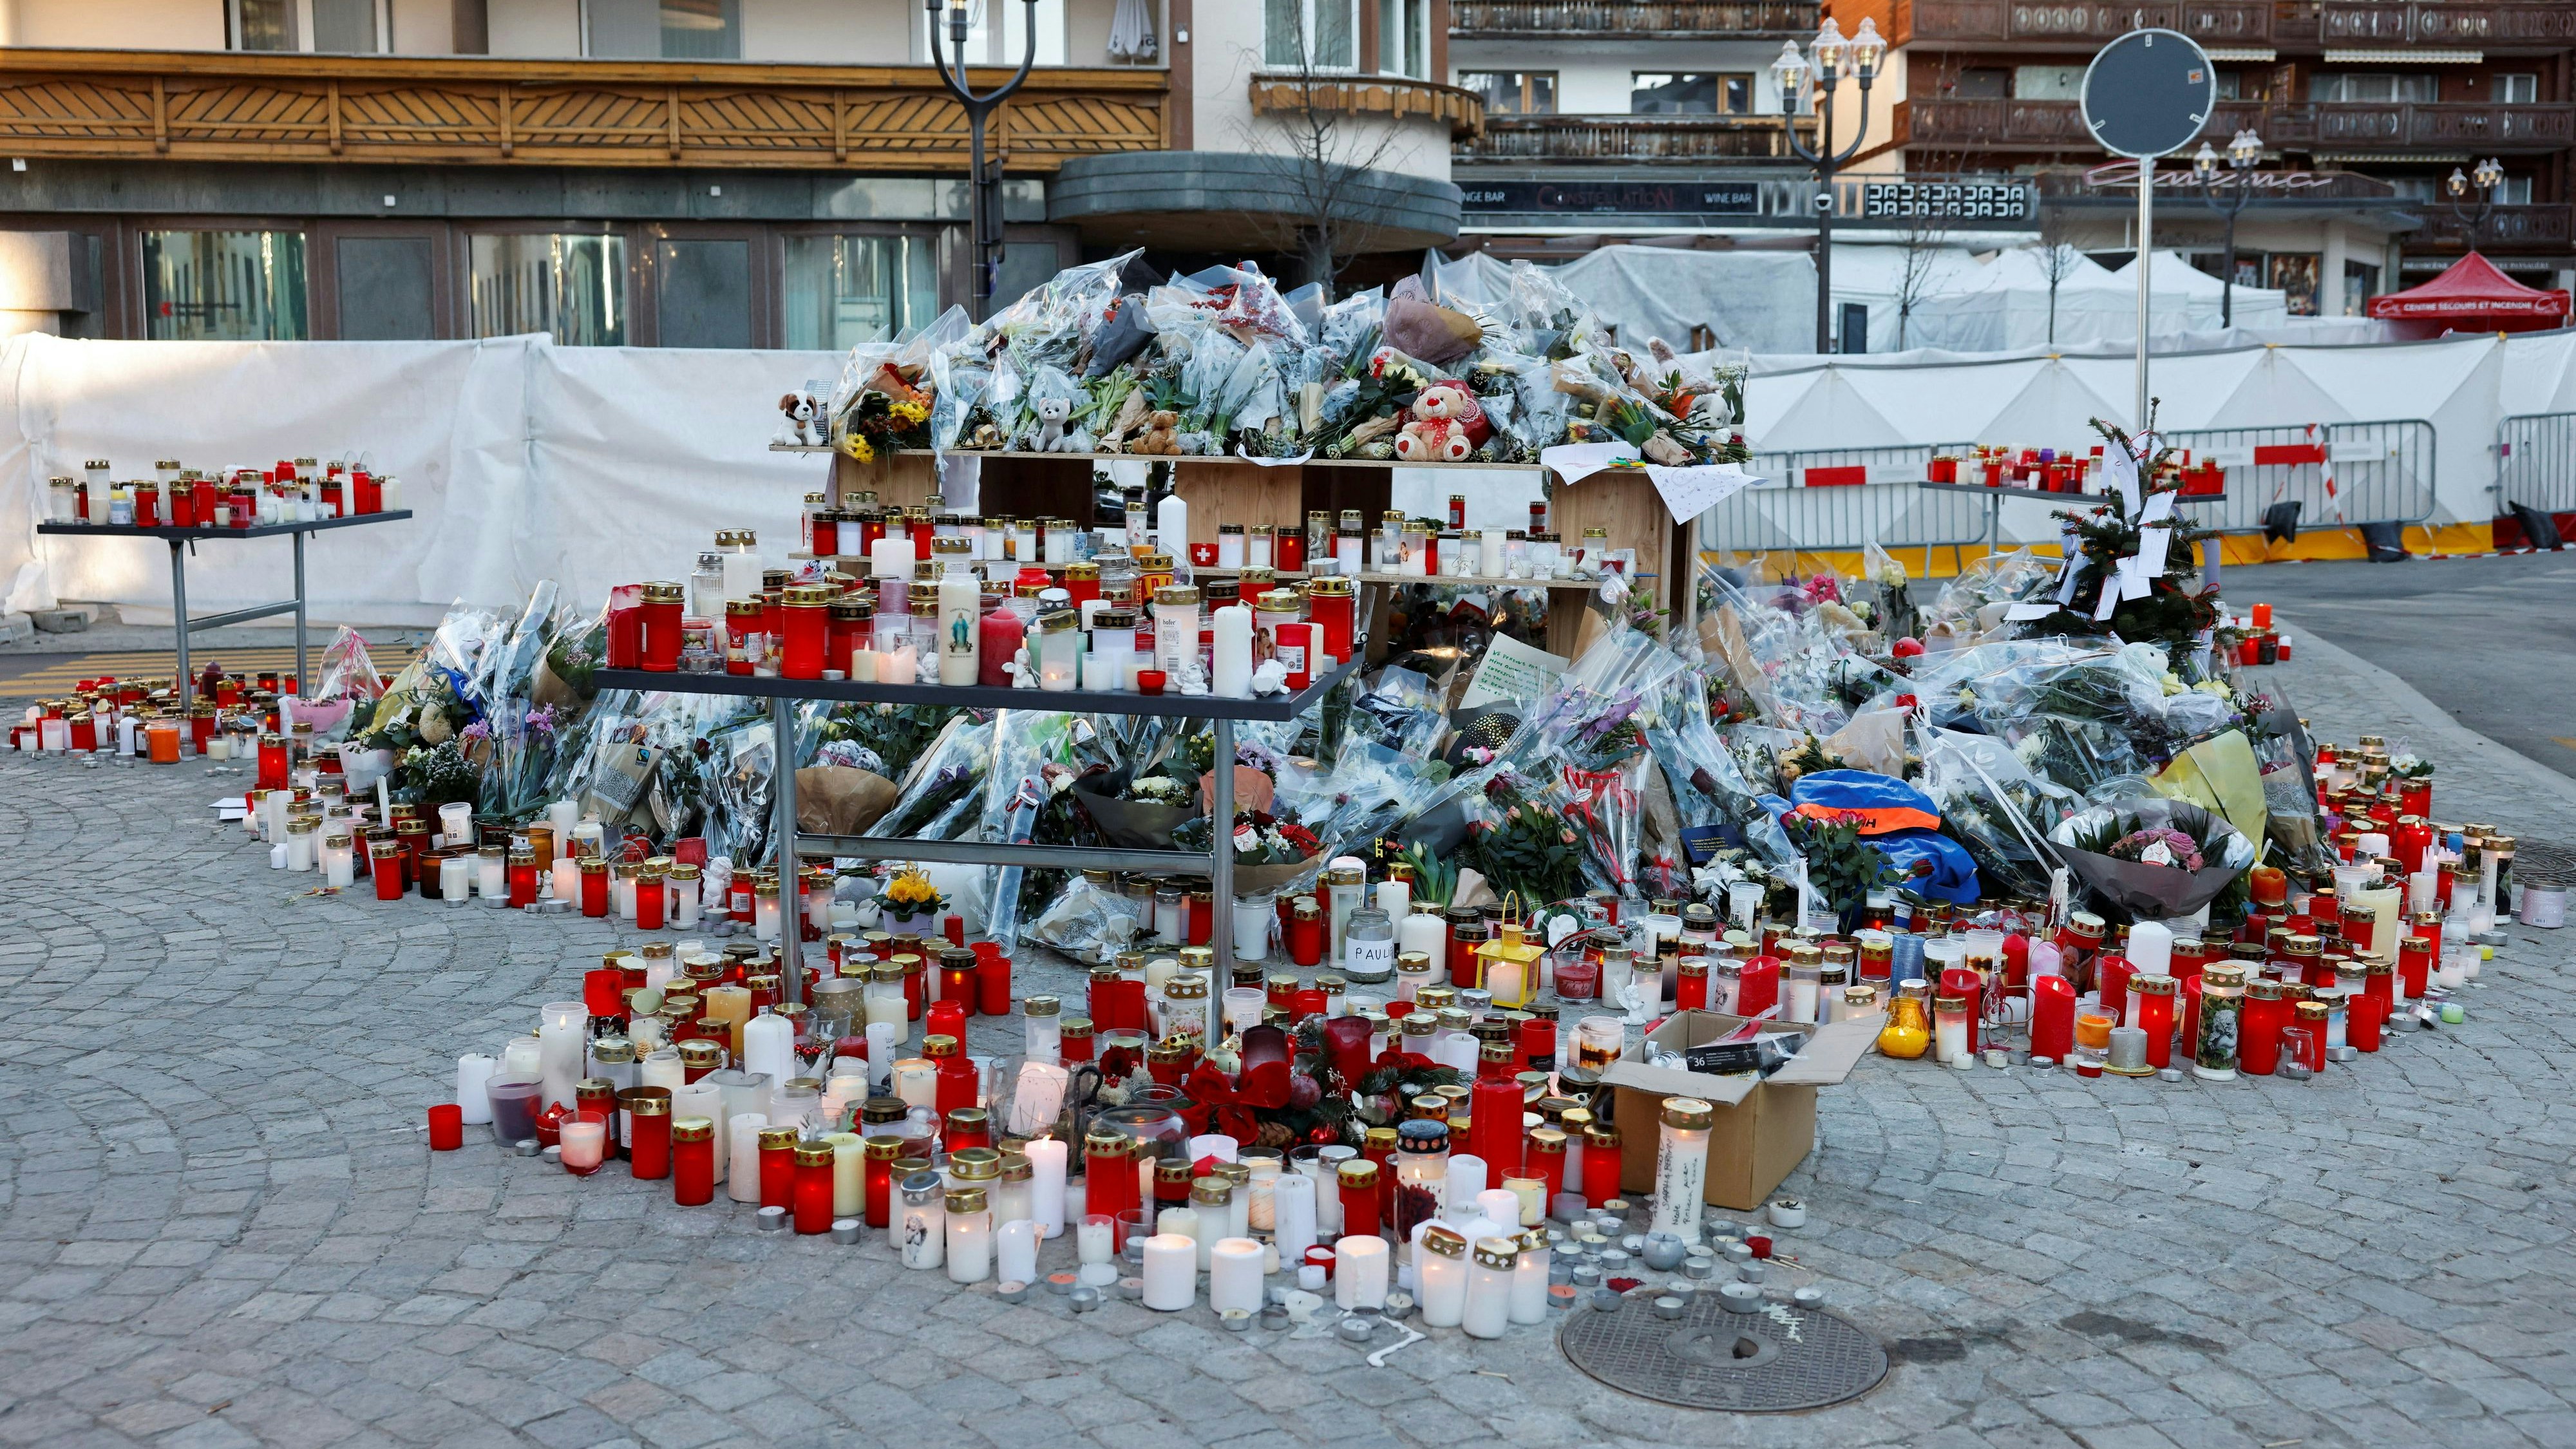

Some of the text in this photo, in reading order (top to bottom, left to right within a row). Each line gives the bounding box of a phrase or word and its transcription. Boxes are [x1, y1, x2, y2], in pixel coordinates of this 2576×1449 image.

[1484, 192, 1504, 202] BAR
[1705, 193, 1752, 204] WINE BAR
[2404, 303, 2437, 311] CENTRE
[2491, 301, 2532, 309] INCENDIE
[1694, 1057, 1705, 1066] 36
[1672, 1204, 1680, 1225] Nicole
